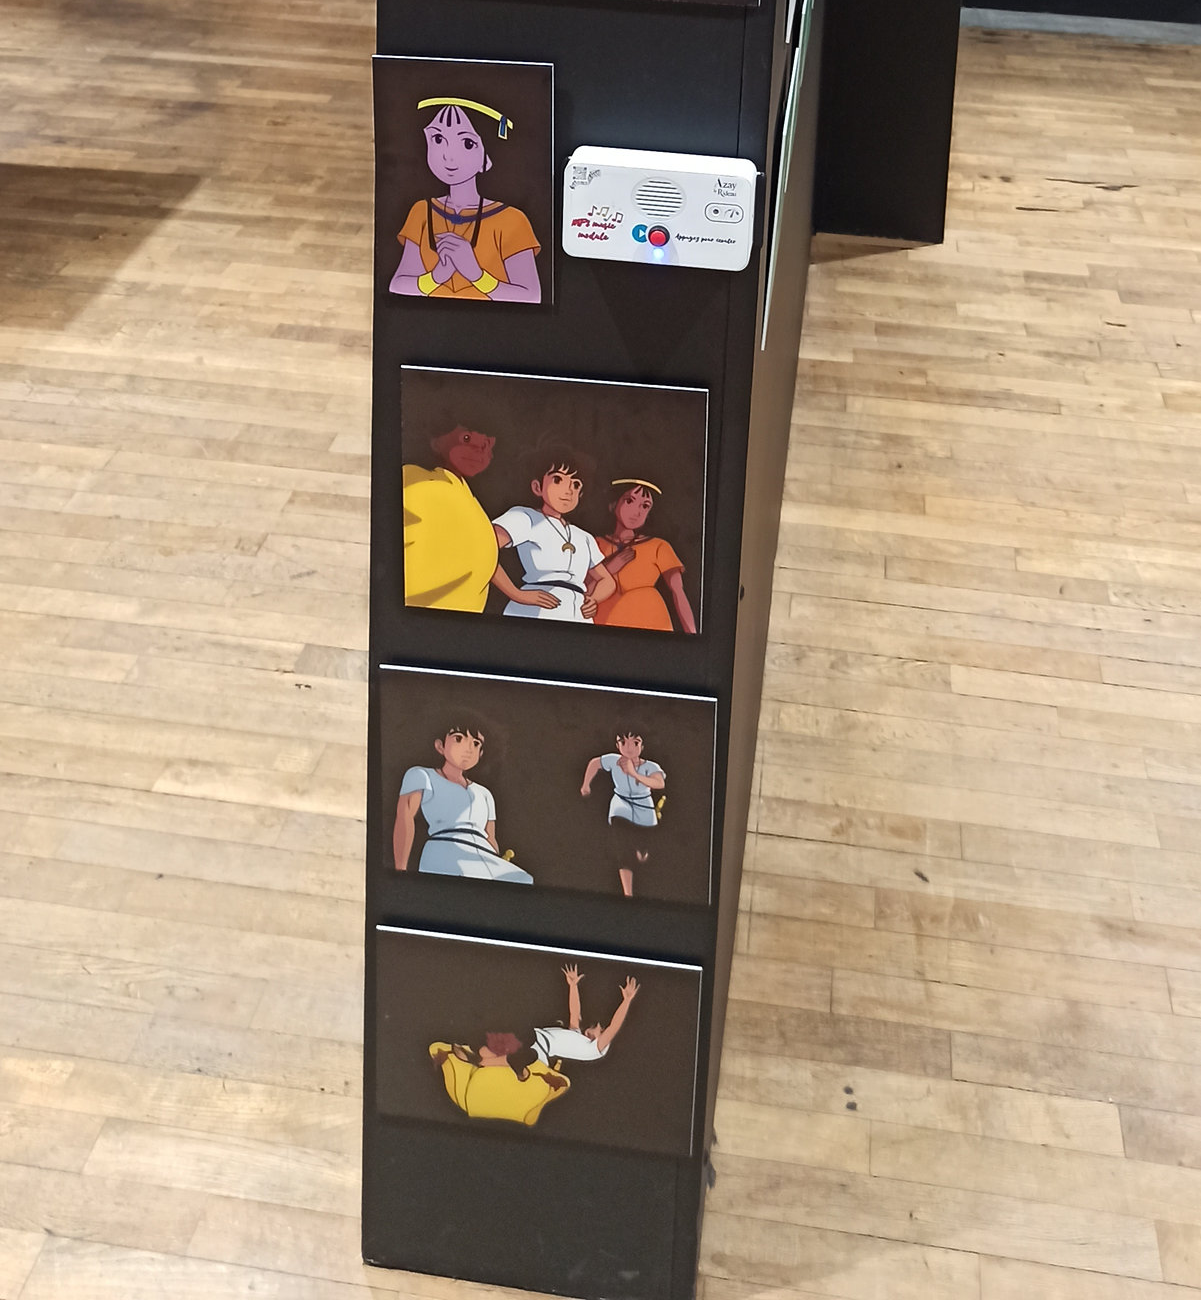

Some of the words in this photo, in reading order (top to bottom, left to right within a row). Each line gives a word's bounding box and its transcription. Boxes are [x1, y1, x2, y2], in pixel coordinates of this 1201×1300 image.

[714, 178, 737, 191] Azay
[591, 221, 616, 230] music
[577, 231, 609, 241] module
